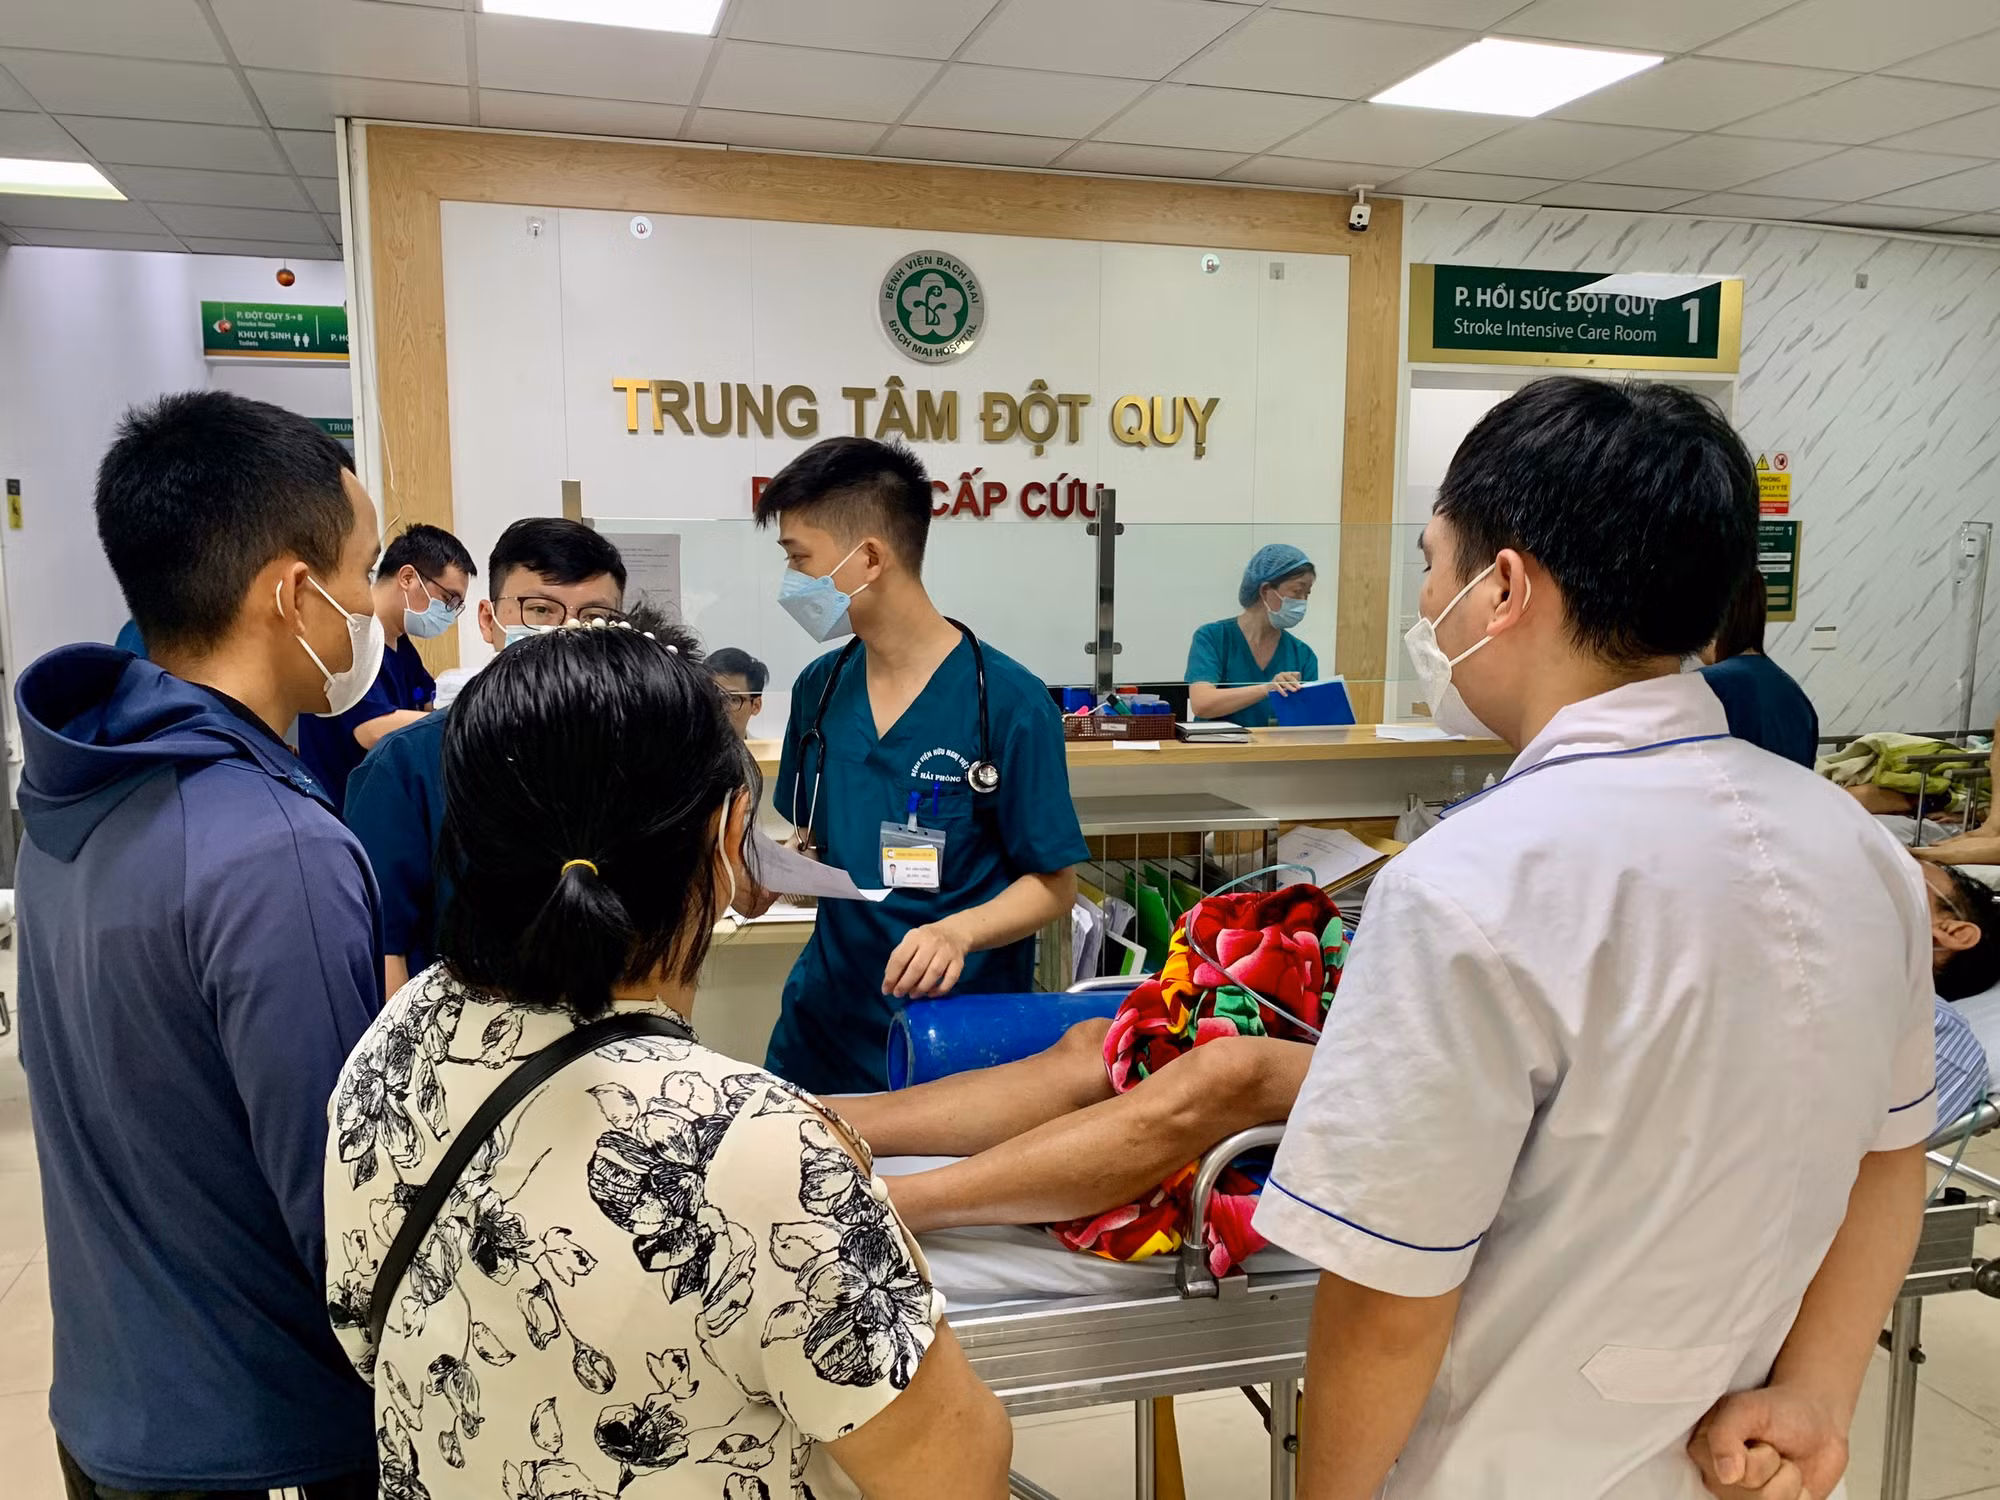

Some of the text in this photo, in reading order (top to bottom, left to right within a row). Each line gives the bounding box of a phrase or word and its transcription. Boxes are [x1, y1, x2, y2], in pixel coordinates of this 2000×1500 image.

[905, 255, 933, 270] VIỆN
[936, 256, 967, 280] BẠCH
[964, 279, 980, 304] MAI
[1455, 286, 1471, 307] P.
[1476, 283, 1514, 309] HỒI
[1520, 287, 1562, 312] SỨC
[1454, 317, 1657, 342] Stroke Intensive Care Room
[1682, 298, 1700, 344] 1
[238, 330, 257, 339] KHU
[270, 331, 291, 340] SINH
[330, 333, 338, 342] P.
[888, 320, 977, 357] BACH MAI HOSPITAL
[328, 422, 353, 432] TRUN
[612, 375, 1220, 458] TRUNG TÂM ĐỘT QUỴ
[931, 467, 1104, 518] CẤP CỨU
[1788, 526, 1793, 536] 1
[920, 770, 934, 780] HẢI
[935, 774, 961, 783] PHÒNG
